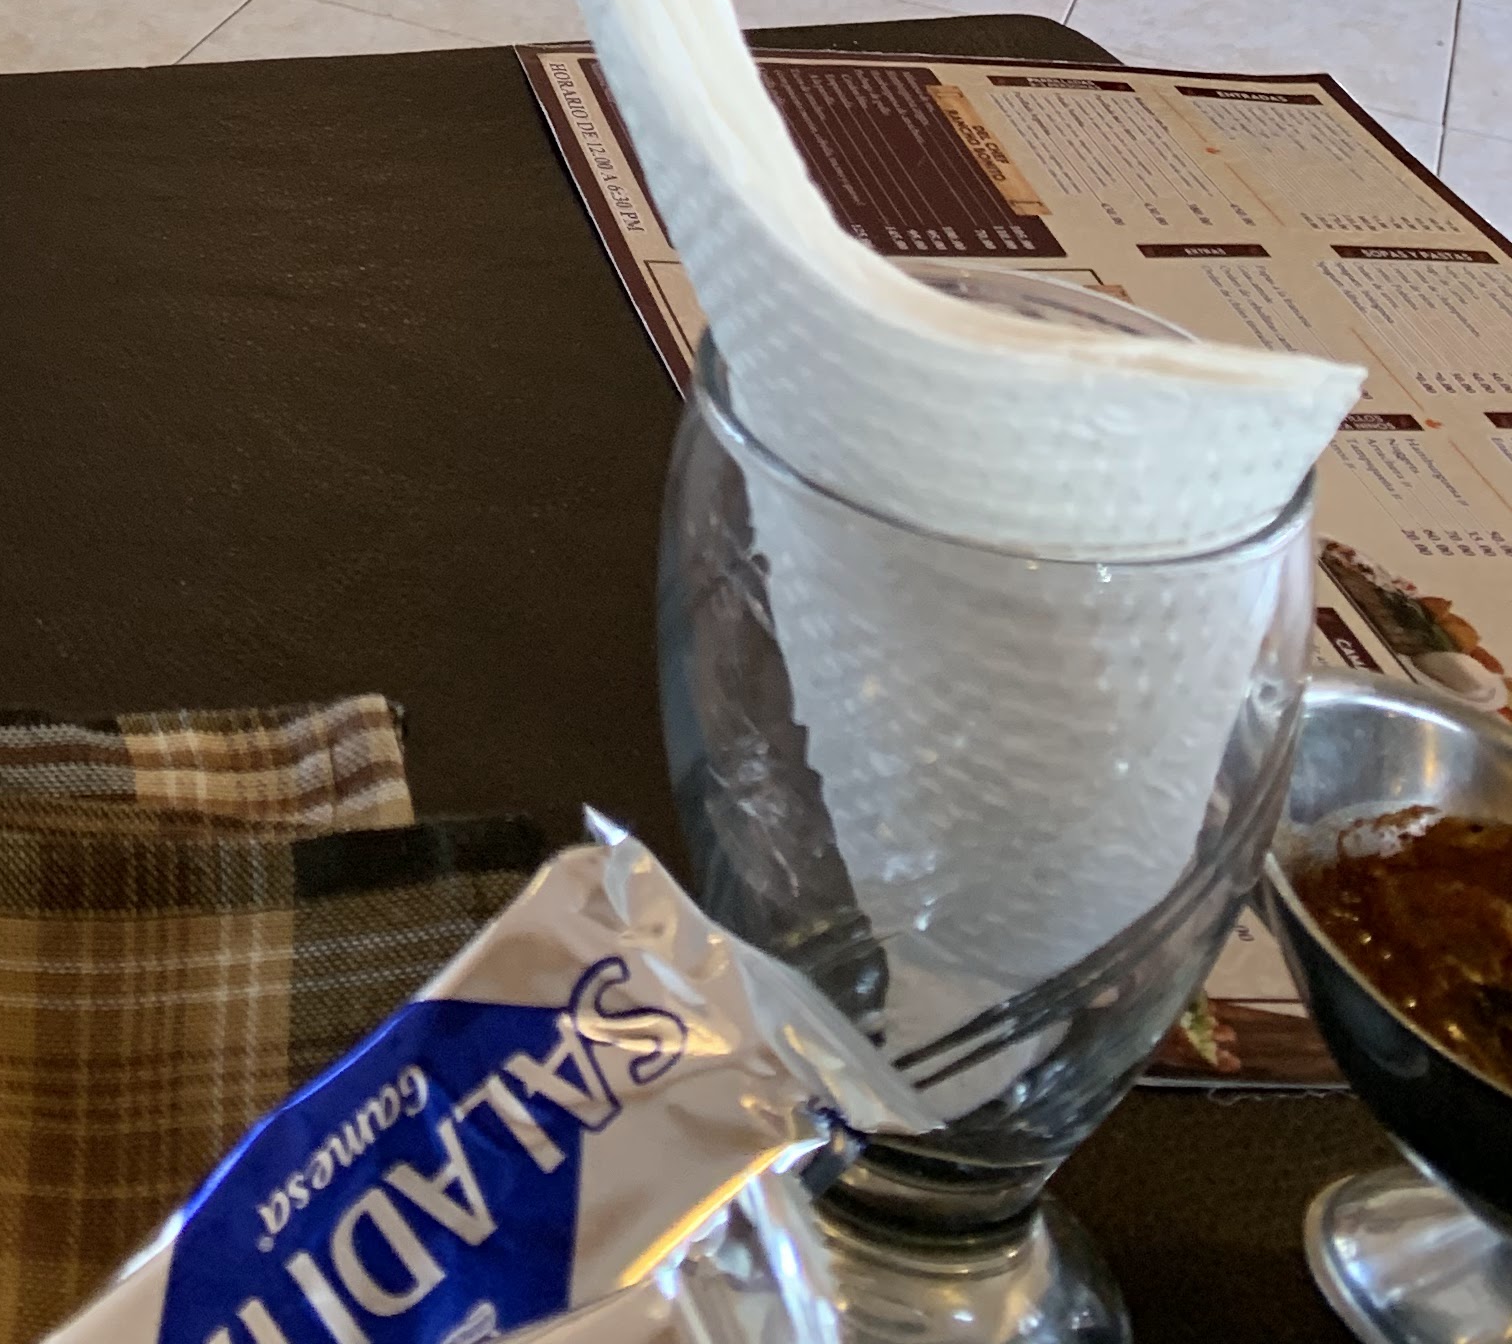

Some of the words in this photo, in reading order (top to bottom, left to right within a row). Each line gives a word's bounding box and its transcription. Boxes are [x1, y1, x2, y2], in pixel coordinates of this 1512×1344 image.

[549, 63, 588, 119] HORARIO
[1215, 90, 1289, 103] ENTRADAS
[576, 122, 599, 139] DE
[943, 109, 981, 145] RANCHO
[973, 148, 1006, 181] BONITO
[972, 125, 991, 141] DEL
[985, 142, 1009, 164] CHEF
[601, 172, 618, 181] A
[607, 184, 633, 208] 6:30
[619, 211, 644, 231] PM
[1183, 247, 1227, 256] EXTRAS
[1361, 248, 1408, 259] SOPAS
[1418, 250, 1473, 262] PASTAS
[1388, 438, 1419, 474] Nuggets
[1405, 438, 1462, 498] Hamburguesa
[205, 955, 686, 1344] SALADI
[256, 1064, 431, 1238] Gamesa
